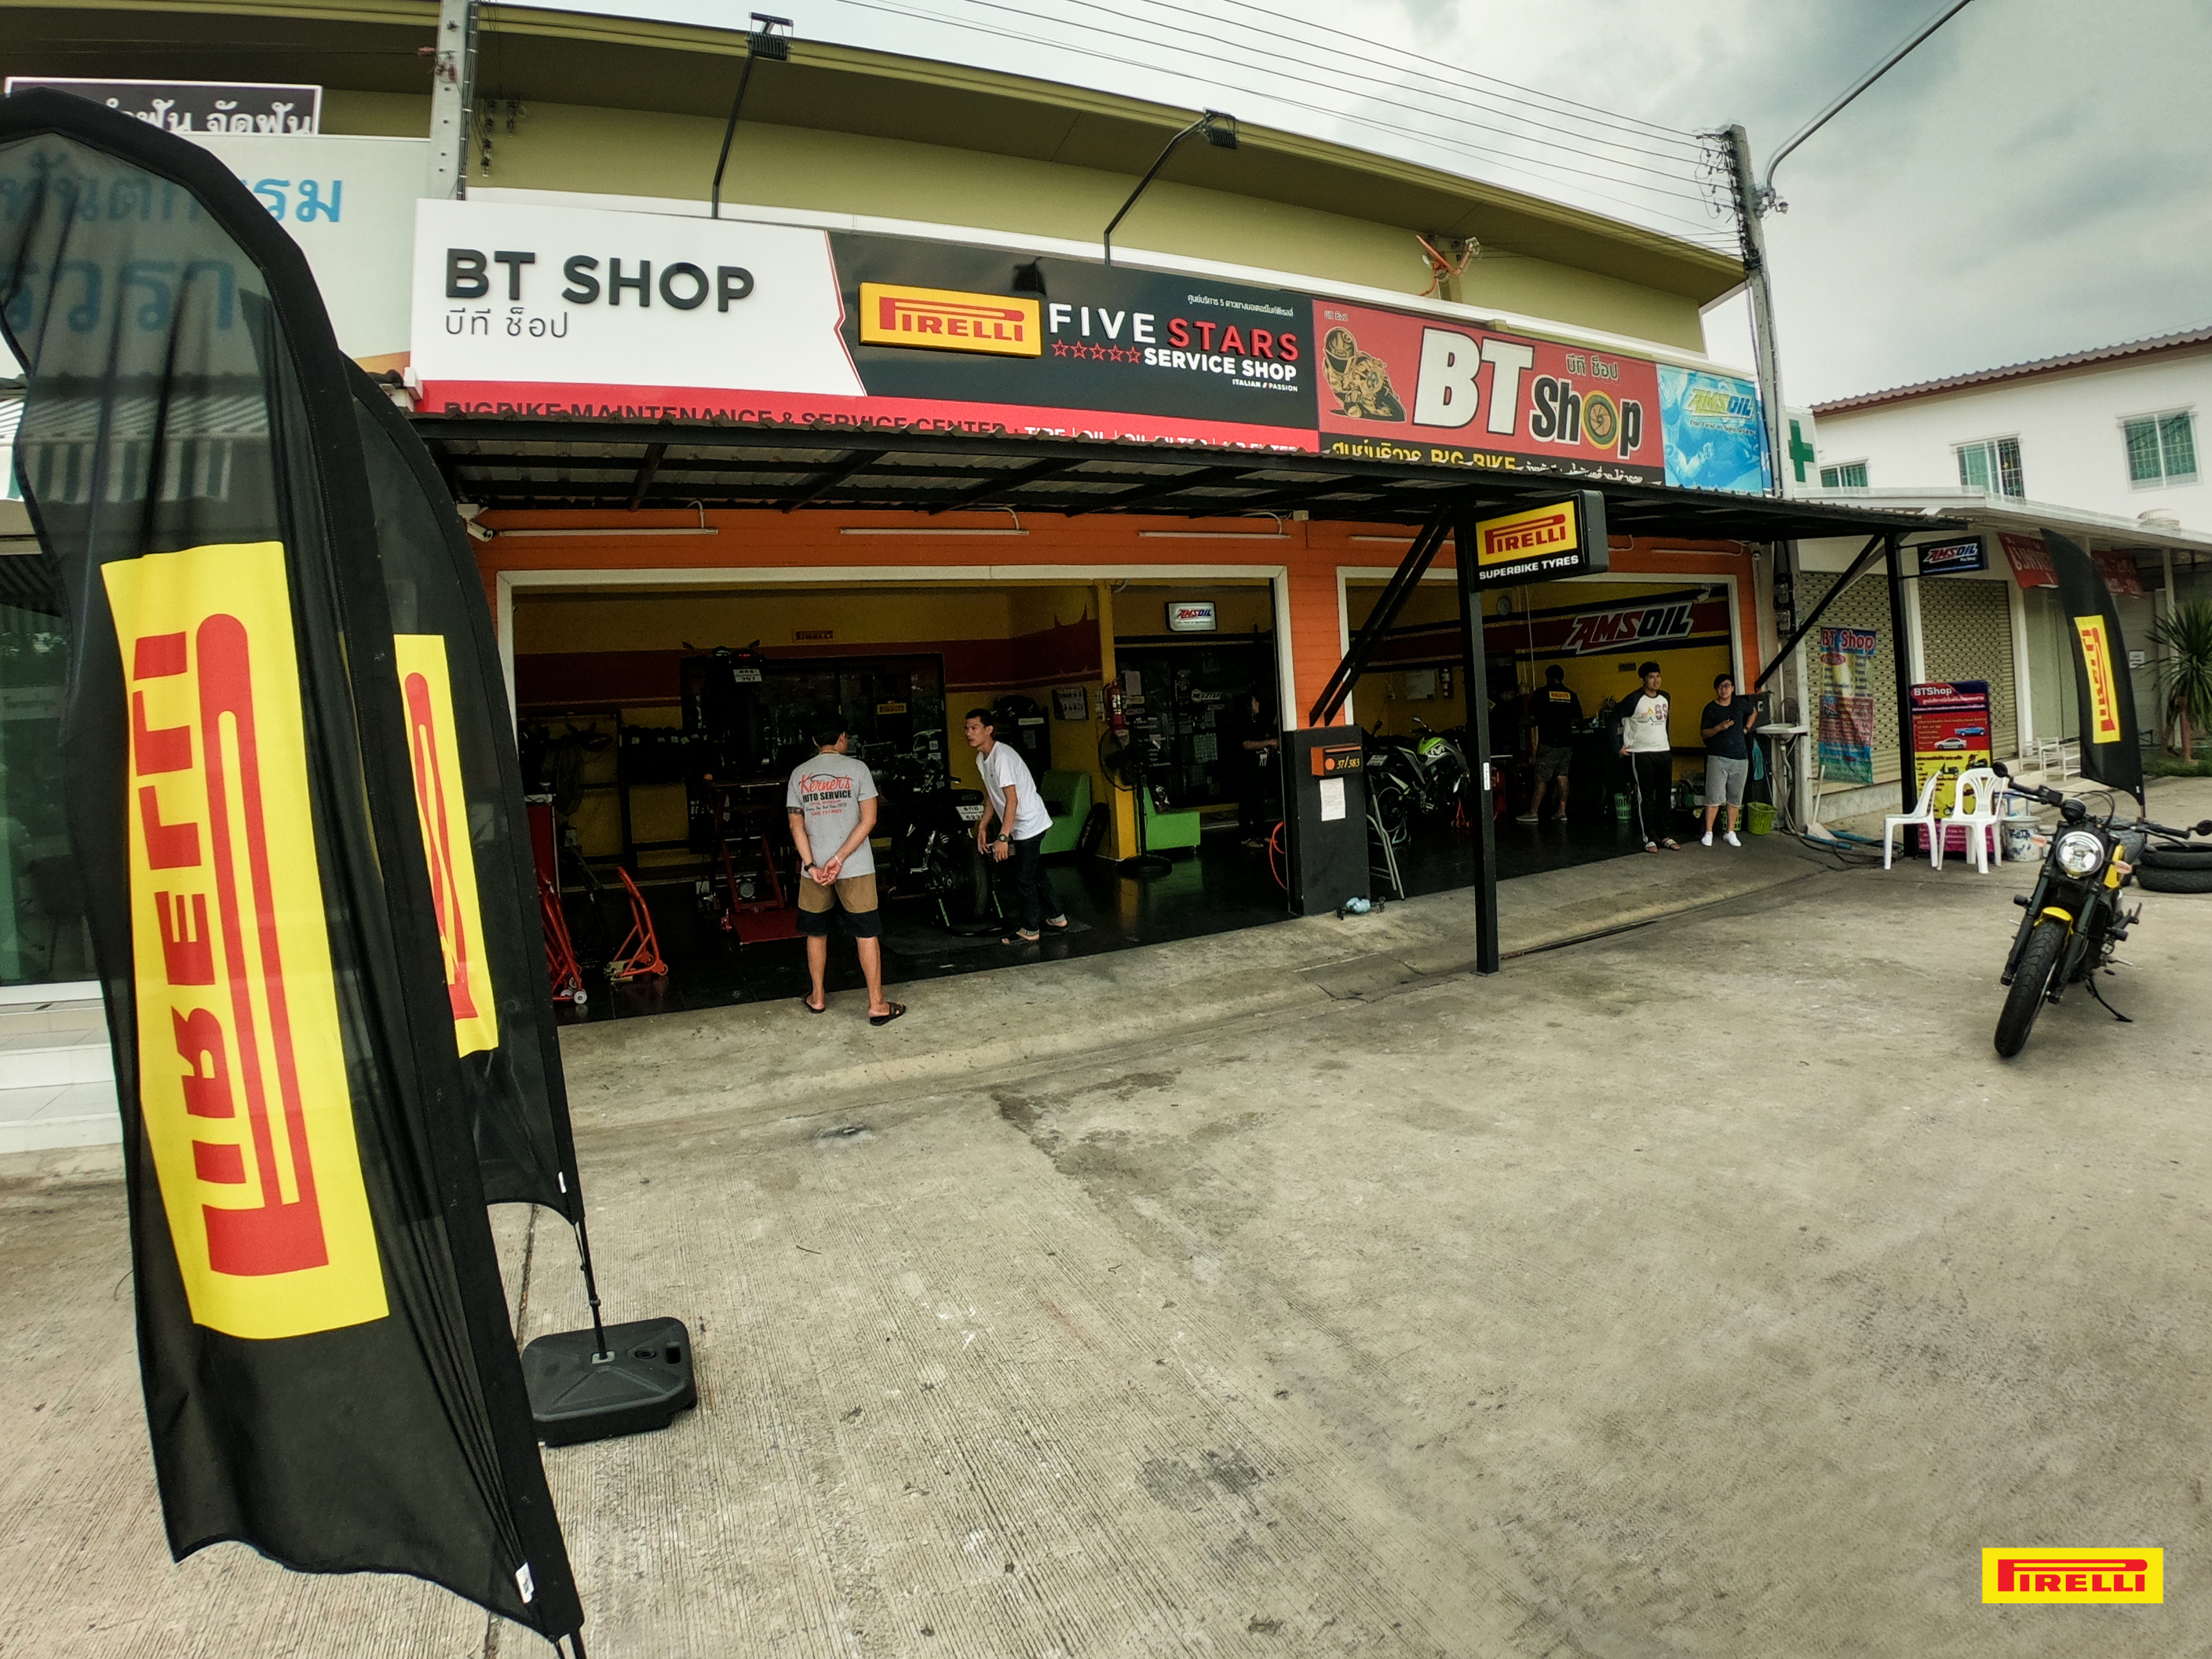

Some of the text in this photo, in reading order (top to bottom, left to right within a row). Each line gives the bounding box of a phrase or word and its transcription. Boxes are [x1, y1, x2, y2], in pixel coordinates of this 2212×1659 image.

[447, 248, 755, 313] BT SHOP
[445, 306, 568, 339] บีที ช็อป
[879, 296, 1025, 342] PIRELLI
[1049, 302, 1300, 363] FIVE STARS
[1144, 347, 1298, 382] SERVICE SHOP
[1565, 353, 1619, 381] บีที ช็อป
[1232, 378, 1299, 392] ITALIAN PASSION
[1413, 326, 1535, 436] BT
[1685, 386, 1755, 419] AMSOIL
[1484, 513, 1566, 555] PIRELLI
[1479, 555, 1579, 580] SUPERBIKE TYRES
[1922, 542, 1978, 563] AMSOIL
[1177, 609, 1211, 619] AMSOIL
[1560, 602, 1694, 654] AMSOIL
[1822, 629, 1874, 654] BT Shop
[1914, 687, 1953, 696] BTShop
[1336, 755, 1360, 769] 37/383
[819, 789, 852, 800] SERVICE
